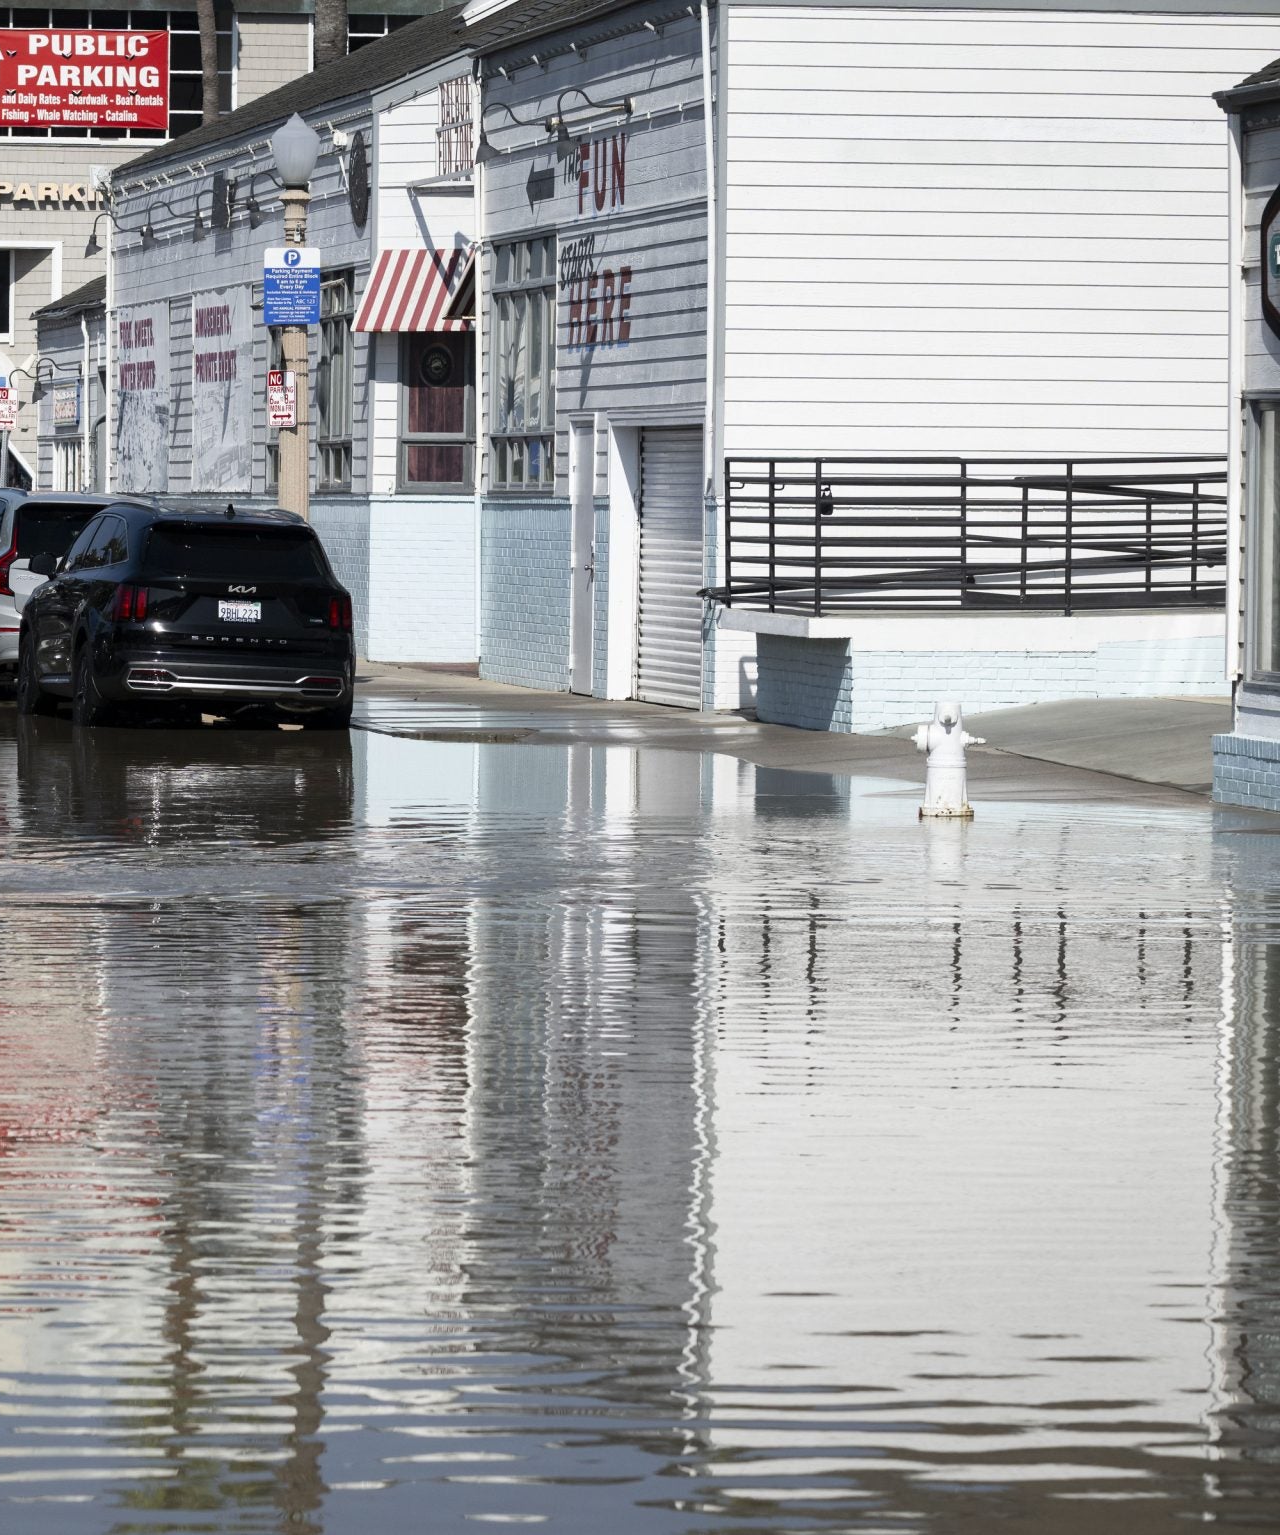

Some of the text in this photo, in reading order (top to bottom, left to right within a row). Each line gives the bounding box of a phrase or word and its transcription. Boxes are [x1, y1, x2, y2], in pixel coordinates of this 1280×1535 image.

[28, 34, 149, 56] PUBLIC
[18, 65, 160, 88] PARKING
[2, 92, 16, 104] and
[18, 93, 37, 106] Daily
[40, 94, 60, 105] Rates
[68, 93, 108, 106] Boardwalk
[116, 94, 133, 106] Boat
[135, 94, 164, 106] Rentals
[2, 108, 138, 124] Fishing Whale Watching Catalina
[578, 133, 626, 214] FUN
[568, 266, 632, 345] HERE
[137, 360, 156, 390] SPORTS
[196, 350, 236, 383] PRIVATE EVENTS
[270, 374, 282, 385] NO
[228, 585, 257, 593] KIA
[192, 635, 287, 645] SORENTO
